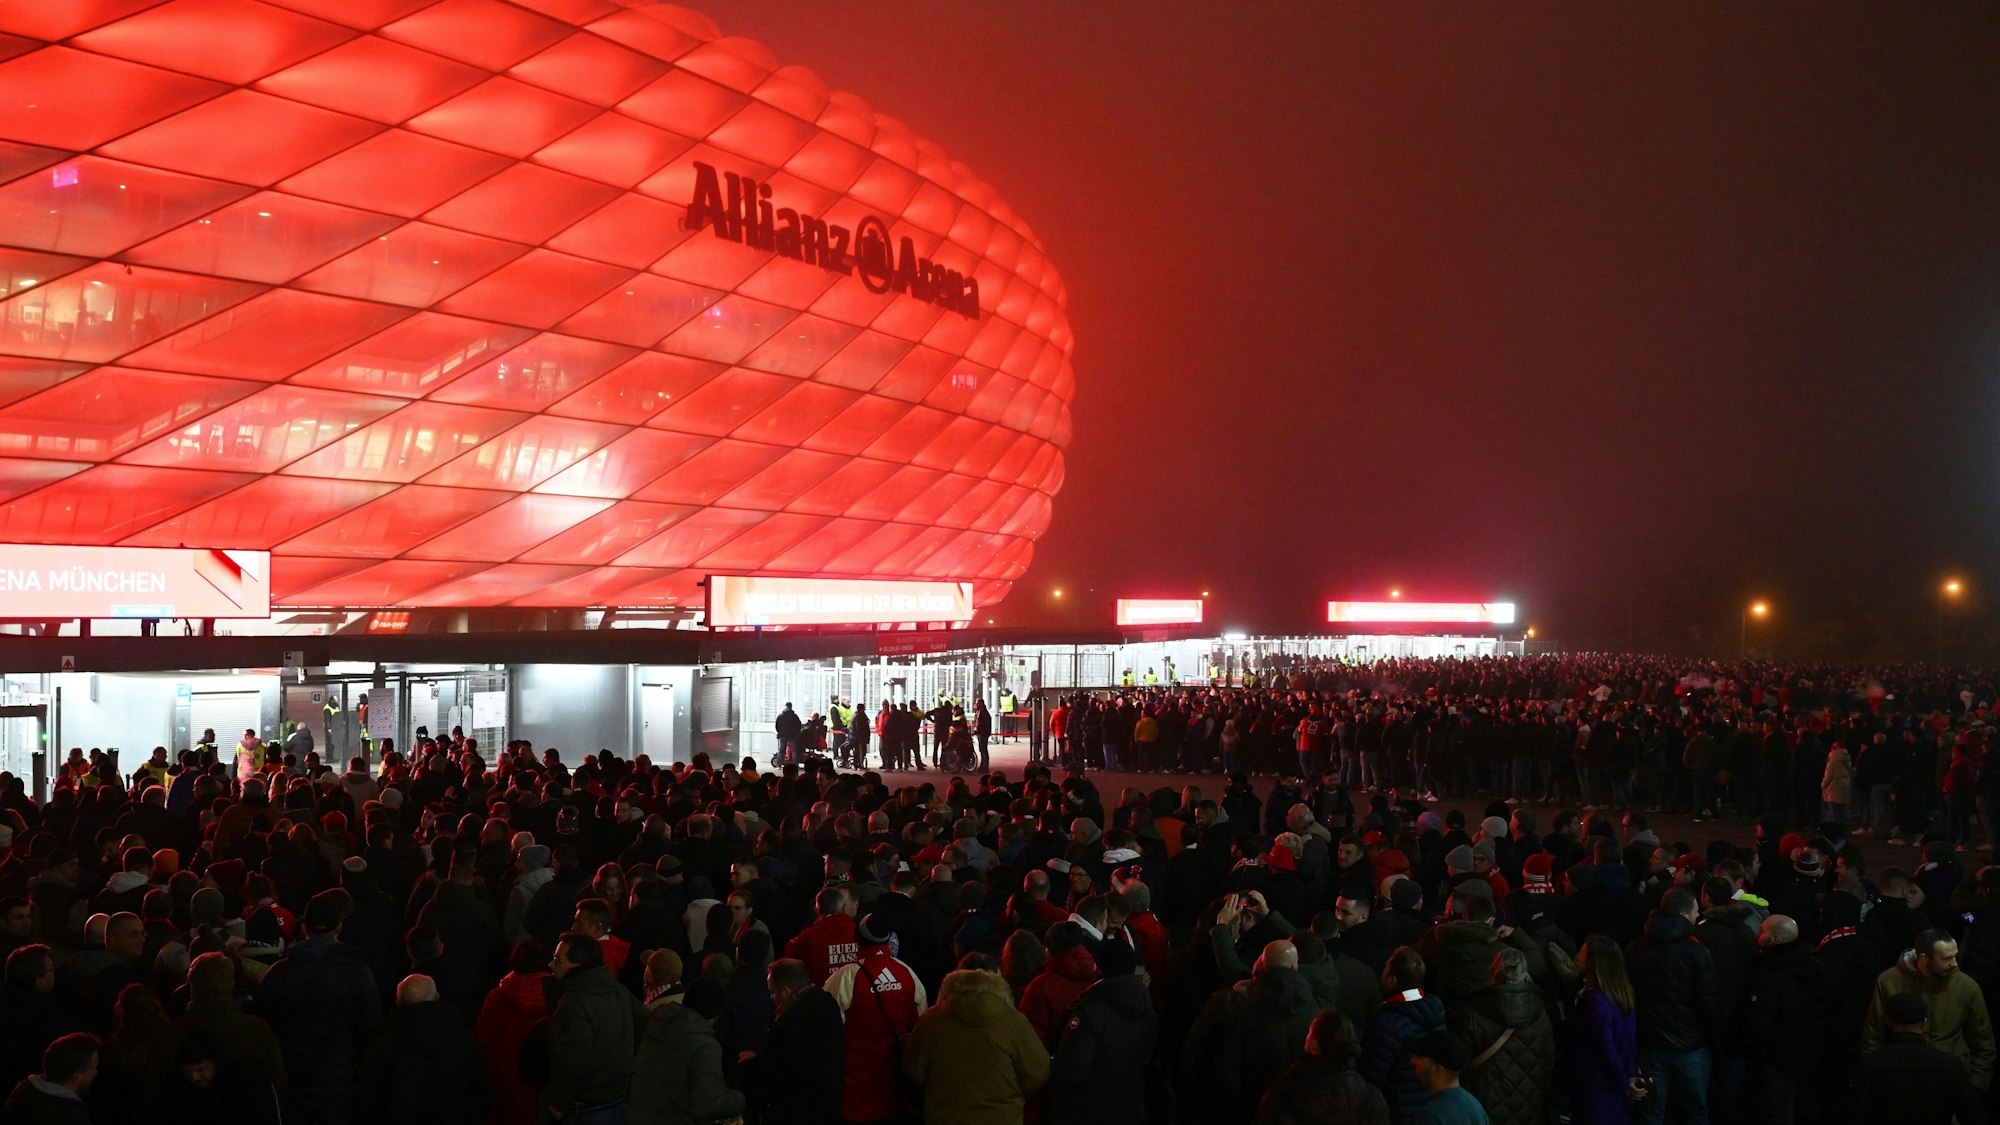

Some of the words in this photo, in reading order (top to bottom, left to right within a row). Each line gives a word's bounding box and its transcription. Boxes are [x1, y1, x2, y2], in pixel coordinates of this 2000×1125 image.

[686, 161, 852, 277] Allianz
[891, 236, 980, 321] Arena
[49, 566, 166, 593] MÜNCHEN
[1307, 720, 1319, 731] 25
